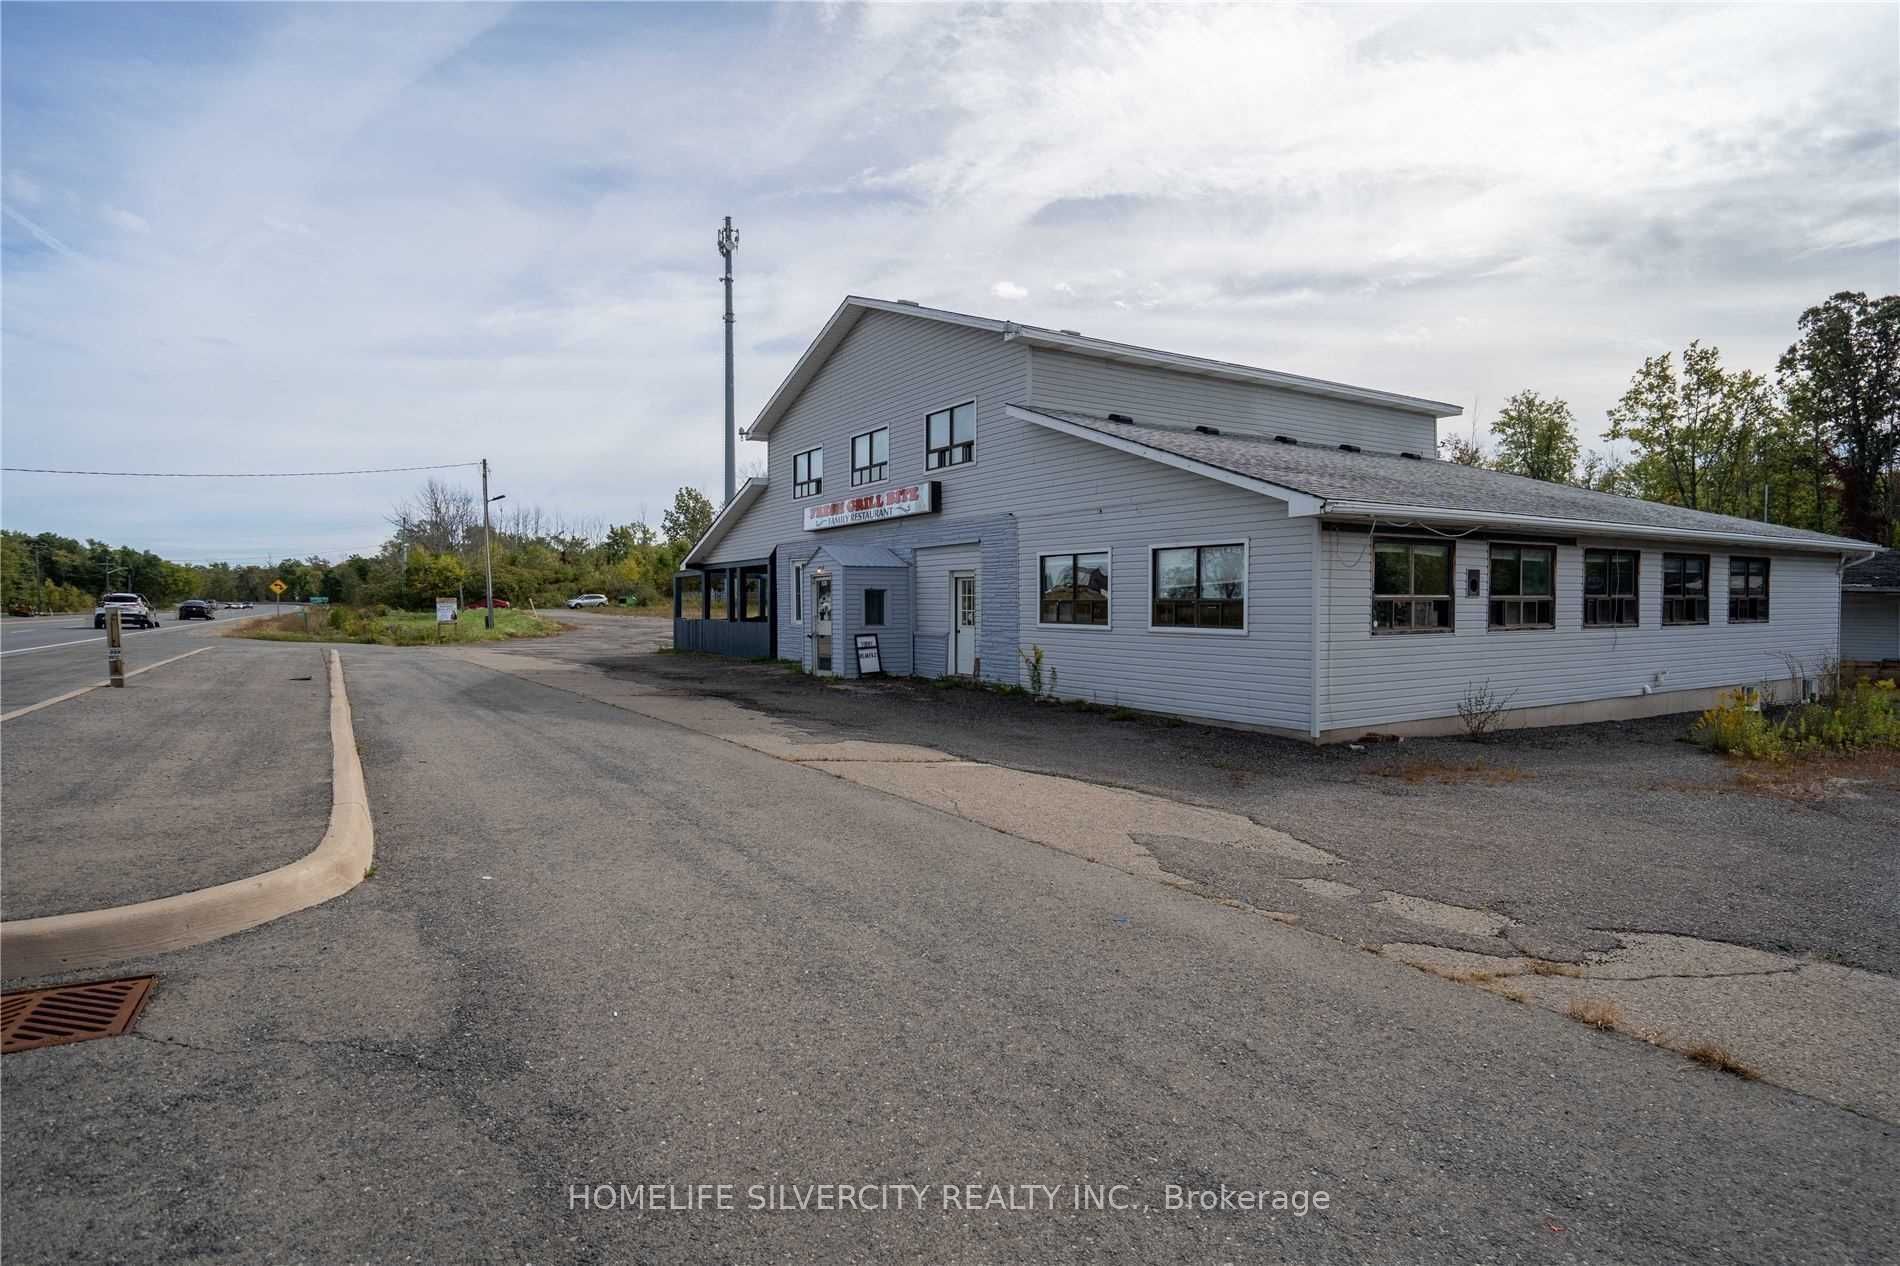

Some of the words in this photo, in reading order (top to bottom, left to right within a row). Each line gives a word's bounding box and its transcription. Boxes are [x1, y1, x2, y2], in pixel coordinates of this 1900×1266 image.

[847, 494, 884, 512] GRILL
[828, 512, 849, 526] FAMILY
[850, 507, 893, 521] RESTAURANT
